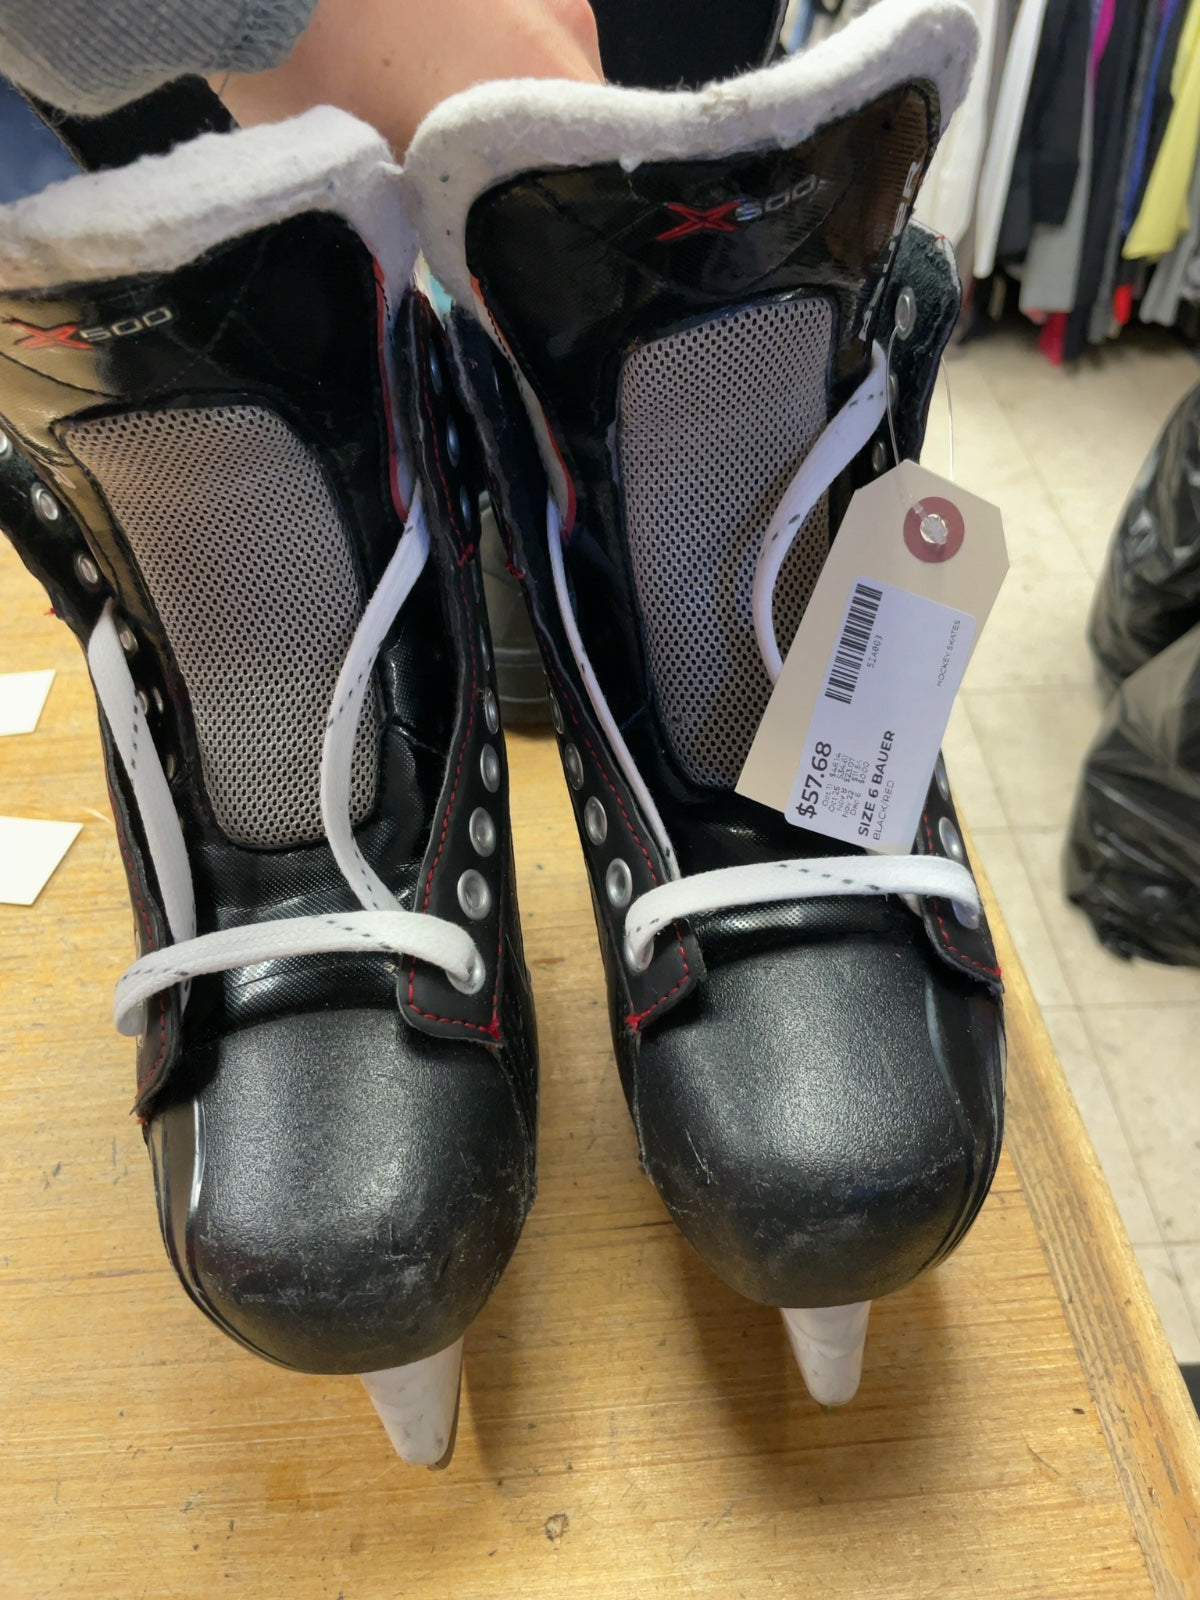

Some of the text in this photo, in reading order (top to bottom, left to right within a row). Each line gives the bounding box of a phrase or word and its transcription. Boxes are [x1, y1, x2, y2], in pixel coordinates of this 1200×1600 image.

[8, 306, 174, 350] X500
[936, 620, 961, 687] HOCKEY SKATES
[795, 741, 832, 819] $57.68
[858, 730, 895, 837] SIZE 6 BAUER
[872, 779, 895, 841] BLACK/RED
